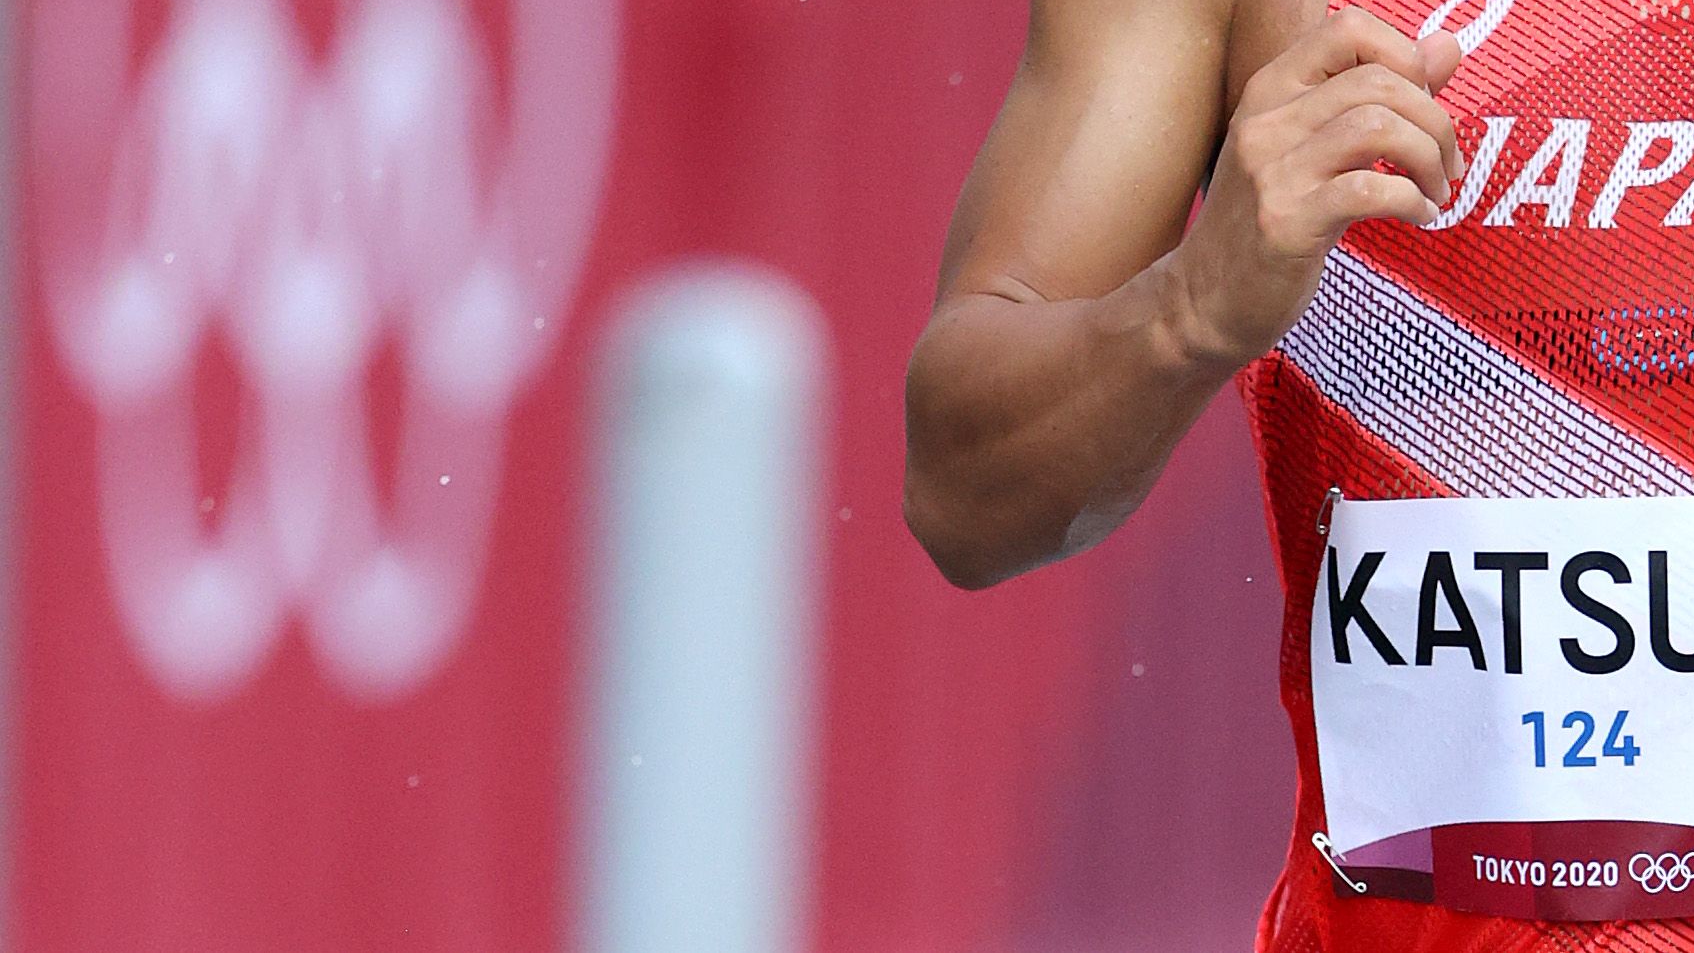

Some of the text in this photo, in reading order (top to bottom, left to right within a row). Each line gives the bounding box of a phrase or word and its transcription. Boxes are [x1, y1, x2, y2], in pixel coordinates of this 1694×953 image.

[1521, 709, 1642, 768] 124
[1472, 854, 1620, 887] TOKYO 2020
